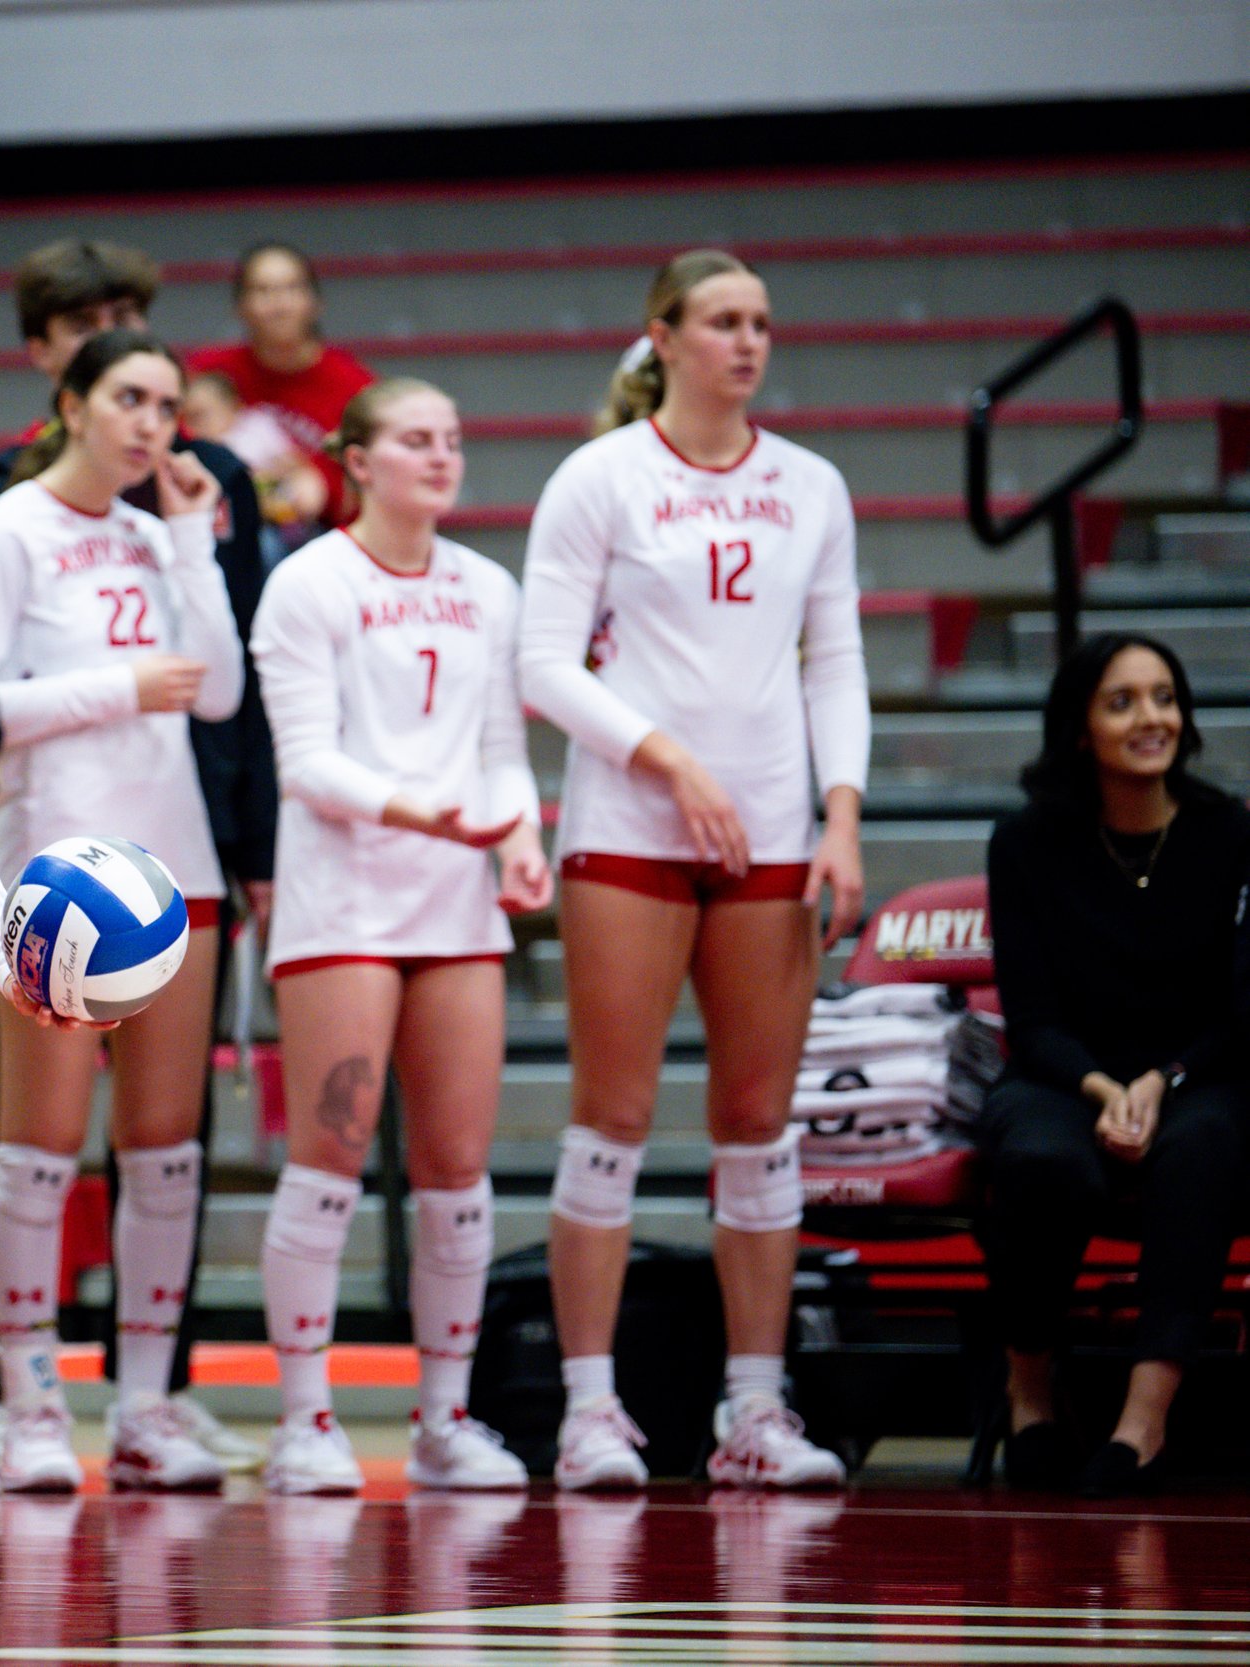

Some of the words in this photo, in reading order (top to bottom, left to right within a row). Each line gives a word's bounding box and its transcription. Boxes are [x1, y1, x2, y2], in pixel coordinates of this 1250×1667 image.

[709, 540, 754, 603] 12
[99, 586, 156, 646] 22
[418, 648, 438, 715] 7
[77, 845, 109, 866] M
[875, 908, 993, 952] MARYL
